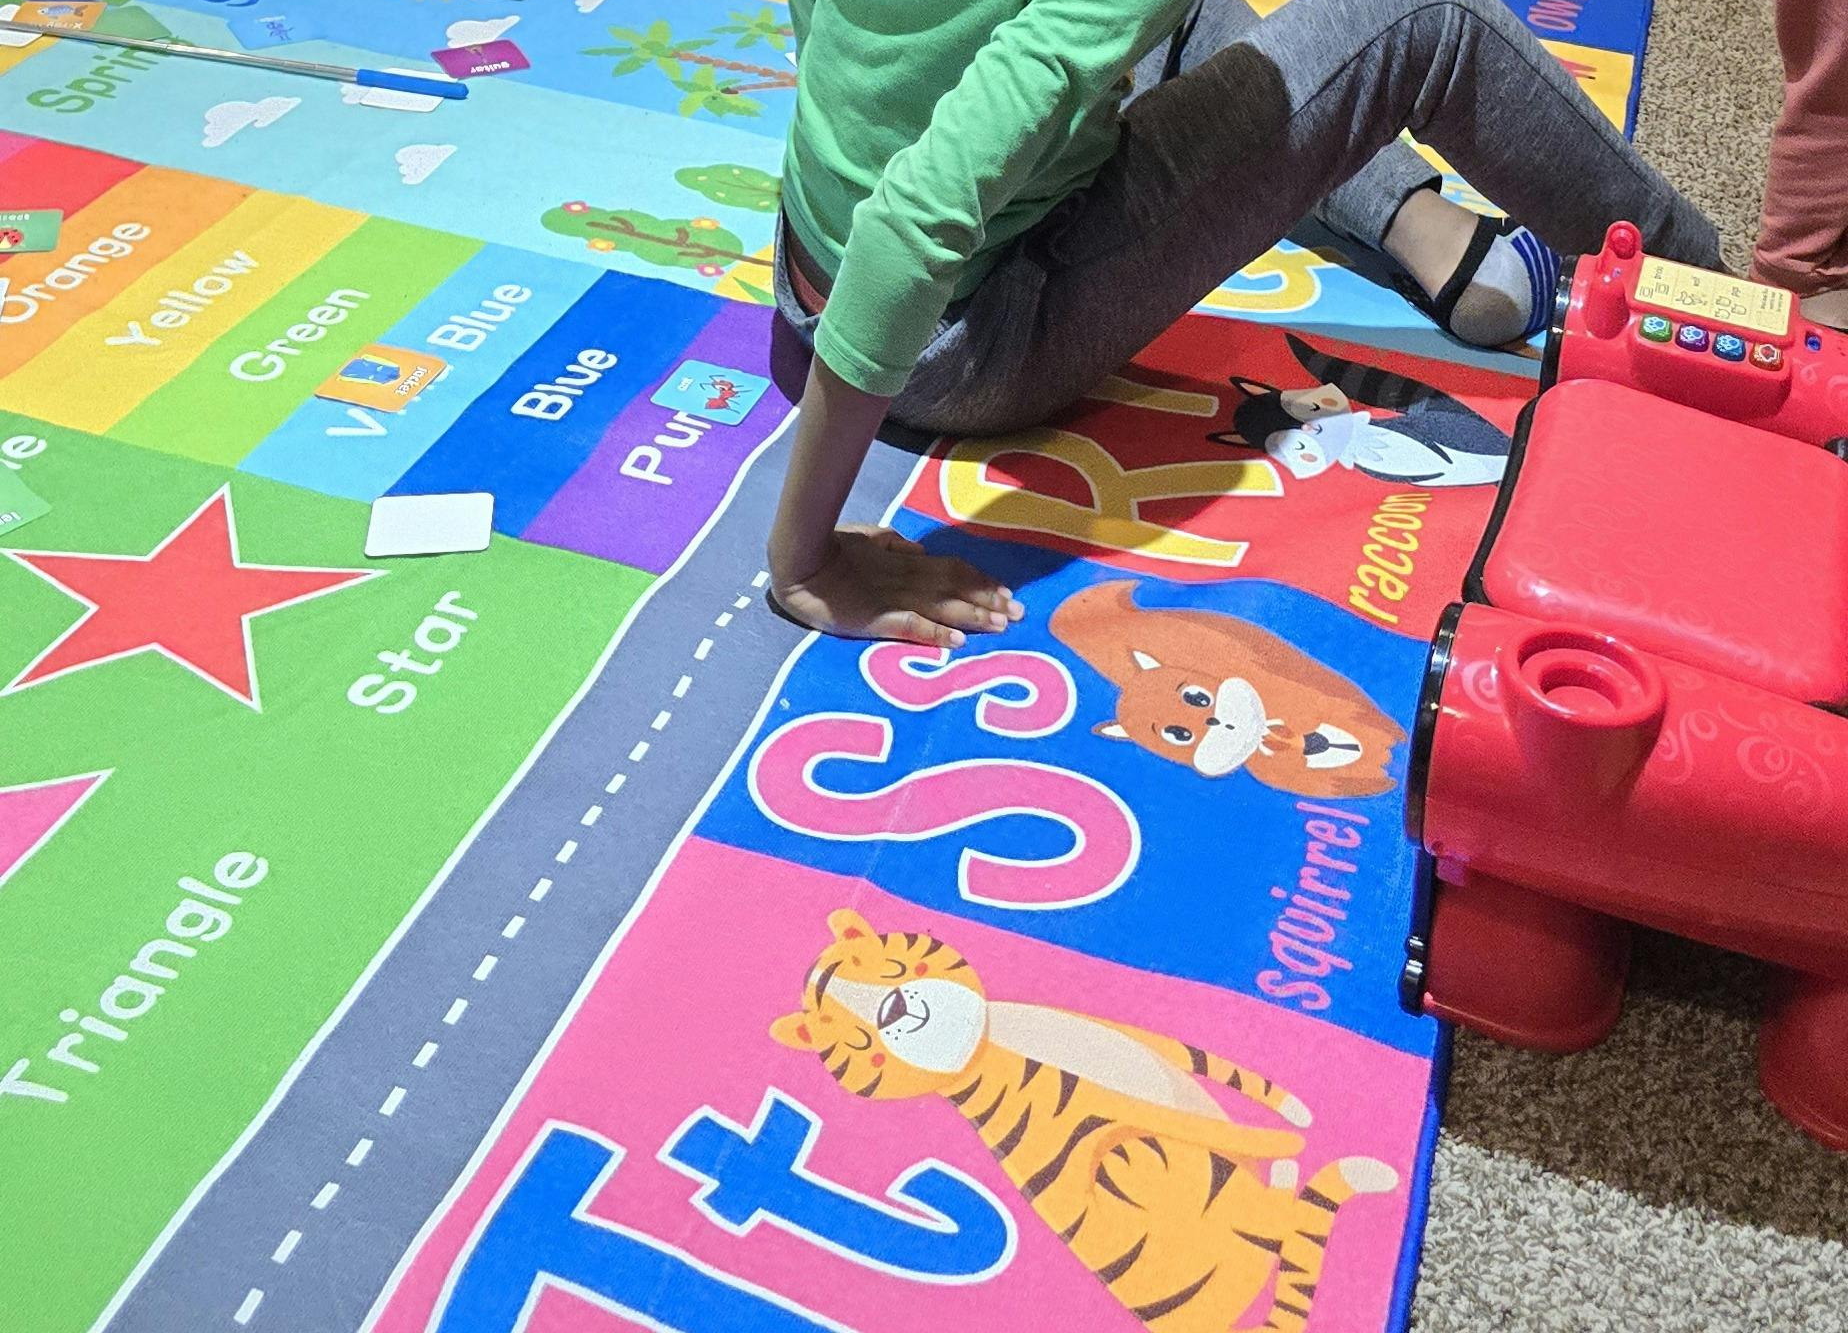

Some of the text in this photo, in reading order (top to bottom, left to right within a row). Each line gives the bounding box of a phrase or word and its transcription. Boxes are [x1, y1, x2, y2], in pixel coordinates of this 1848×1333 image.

[0, 221, 151, 325] Orange
[103, 247, 260, 351] Yellow
[426, 281, 534, 354] Blue
[228, 286, 371, 383] Green
[509, 346, 619, 422] Blue
[620, 409, 714, 487] Pur
[1347, 493, 1432, 627] raccoon
[346, 589, 479, 714] Star
[747, 639, 1142, 911] Ss
[1256, 801, 1368, 1012] squirrel
[0, 848, 270, 1103] Triangle
